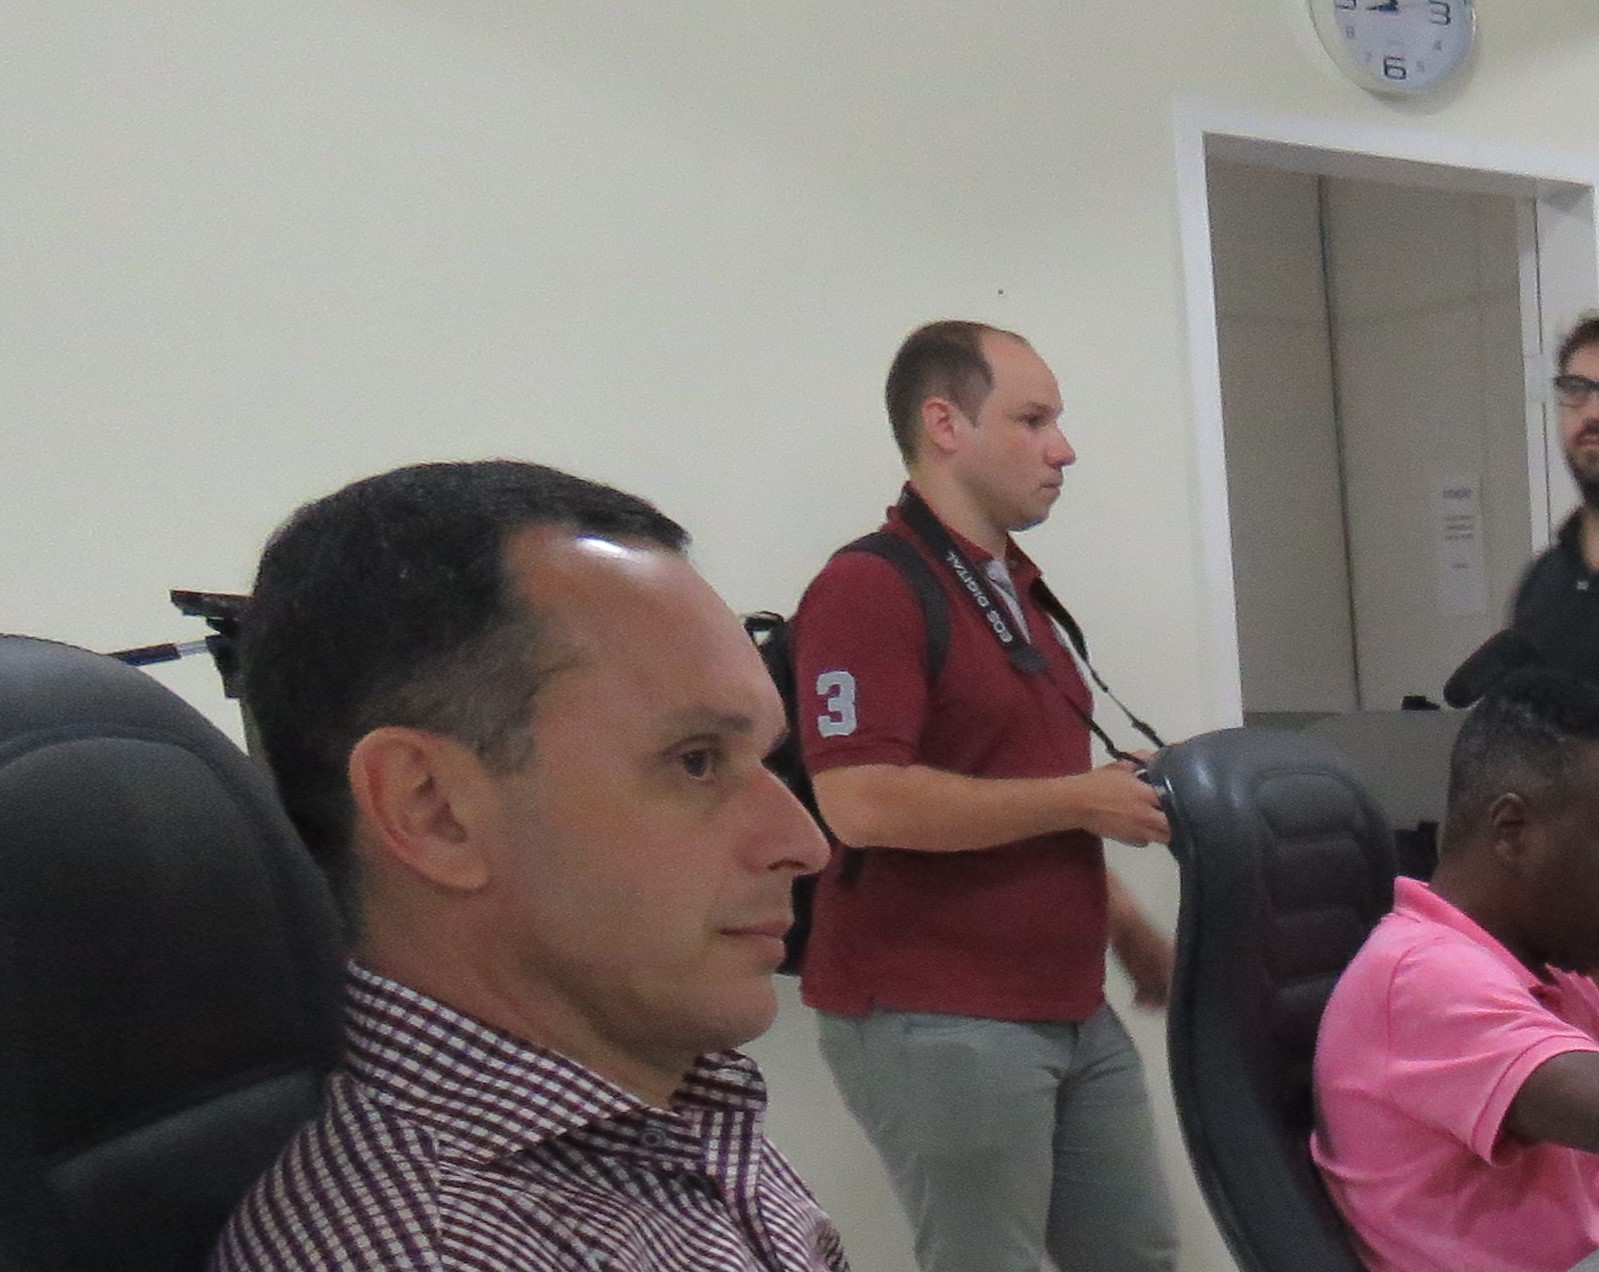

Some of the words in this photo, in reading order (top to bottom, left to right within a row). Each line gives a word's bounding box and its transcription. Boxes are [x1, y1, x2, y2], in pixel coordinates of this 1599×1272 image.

[1428, 0, 1452, 26] 3
[1382, 55, 1407, 80] 6
[946, 551, 991, 608] DIGITAL
[986, 609, 1014, 643] EOS
[815, 669, 858, 738] 3
